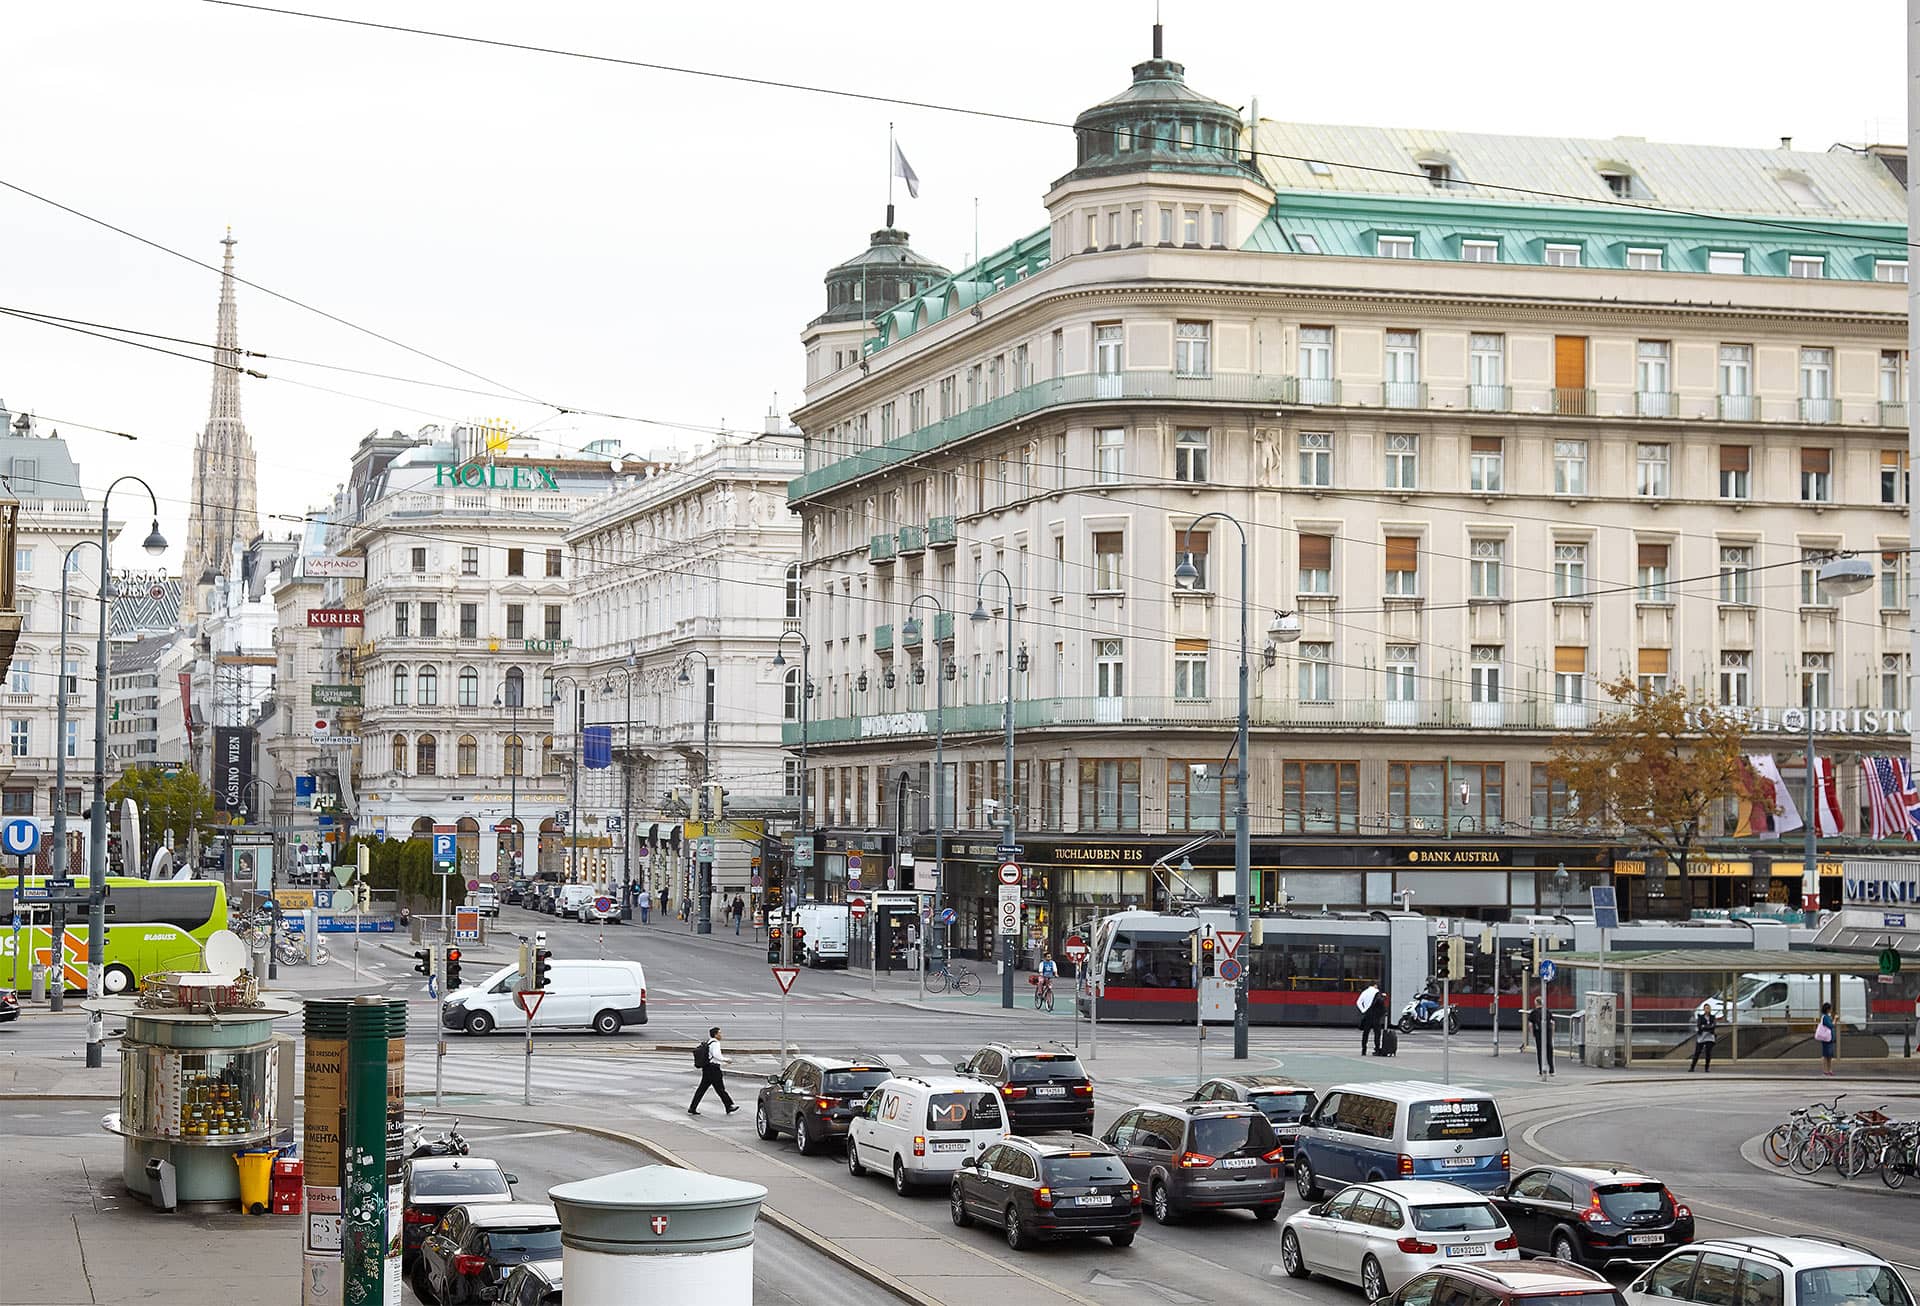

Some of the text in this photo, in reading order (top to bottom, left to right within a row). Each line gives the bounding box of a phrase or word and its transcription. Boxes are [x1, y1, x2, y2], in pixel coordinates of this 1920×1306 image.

[433, 463, 560, 491] ROLEX
[311, 613, 361, 623] KURIER
[226, 736, 240, 806] CASINO WIEN
[9, 825, 34, 851] U
[1055, 848, 1143, 860] TUCHLAUBEN EIS
[1421, 851, 1500, 862] BANK AUSTRIA
[1687, 862, 1735, 874] HOTEL
[932, 1103, 967, 1122] MD
[310, 1133, 340, 1144] MEHTA
